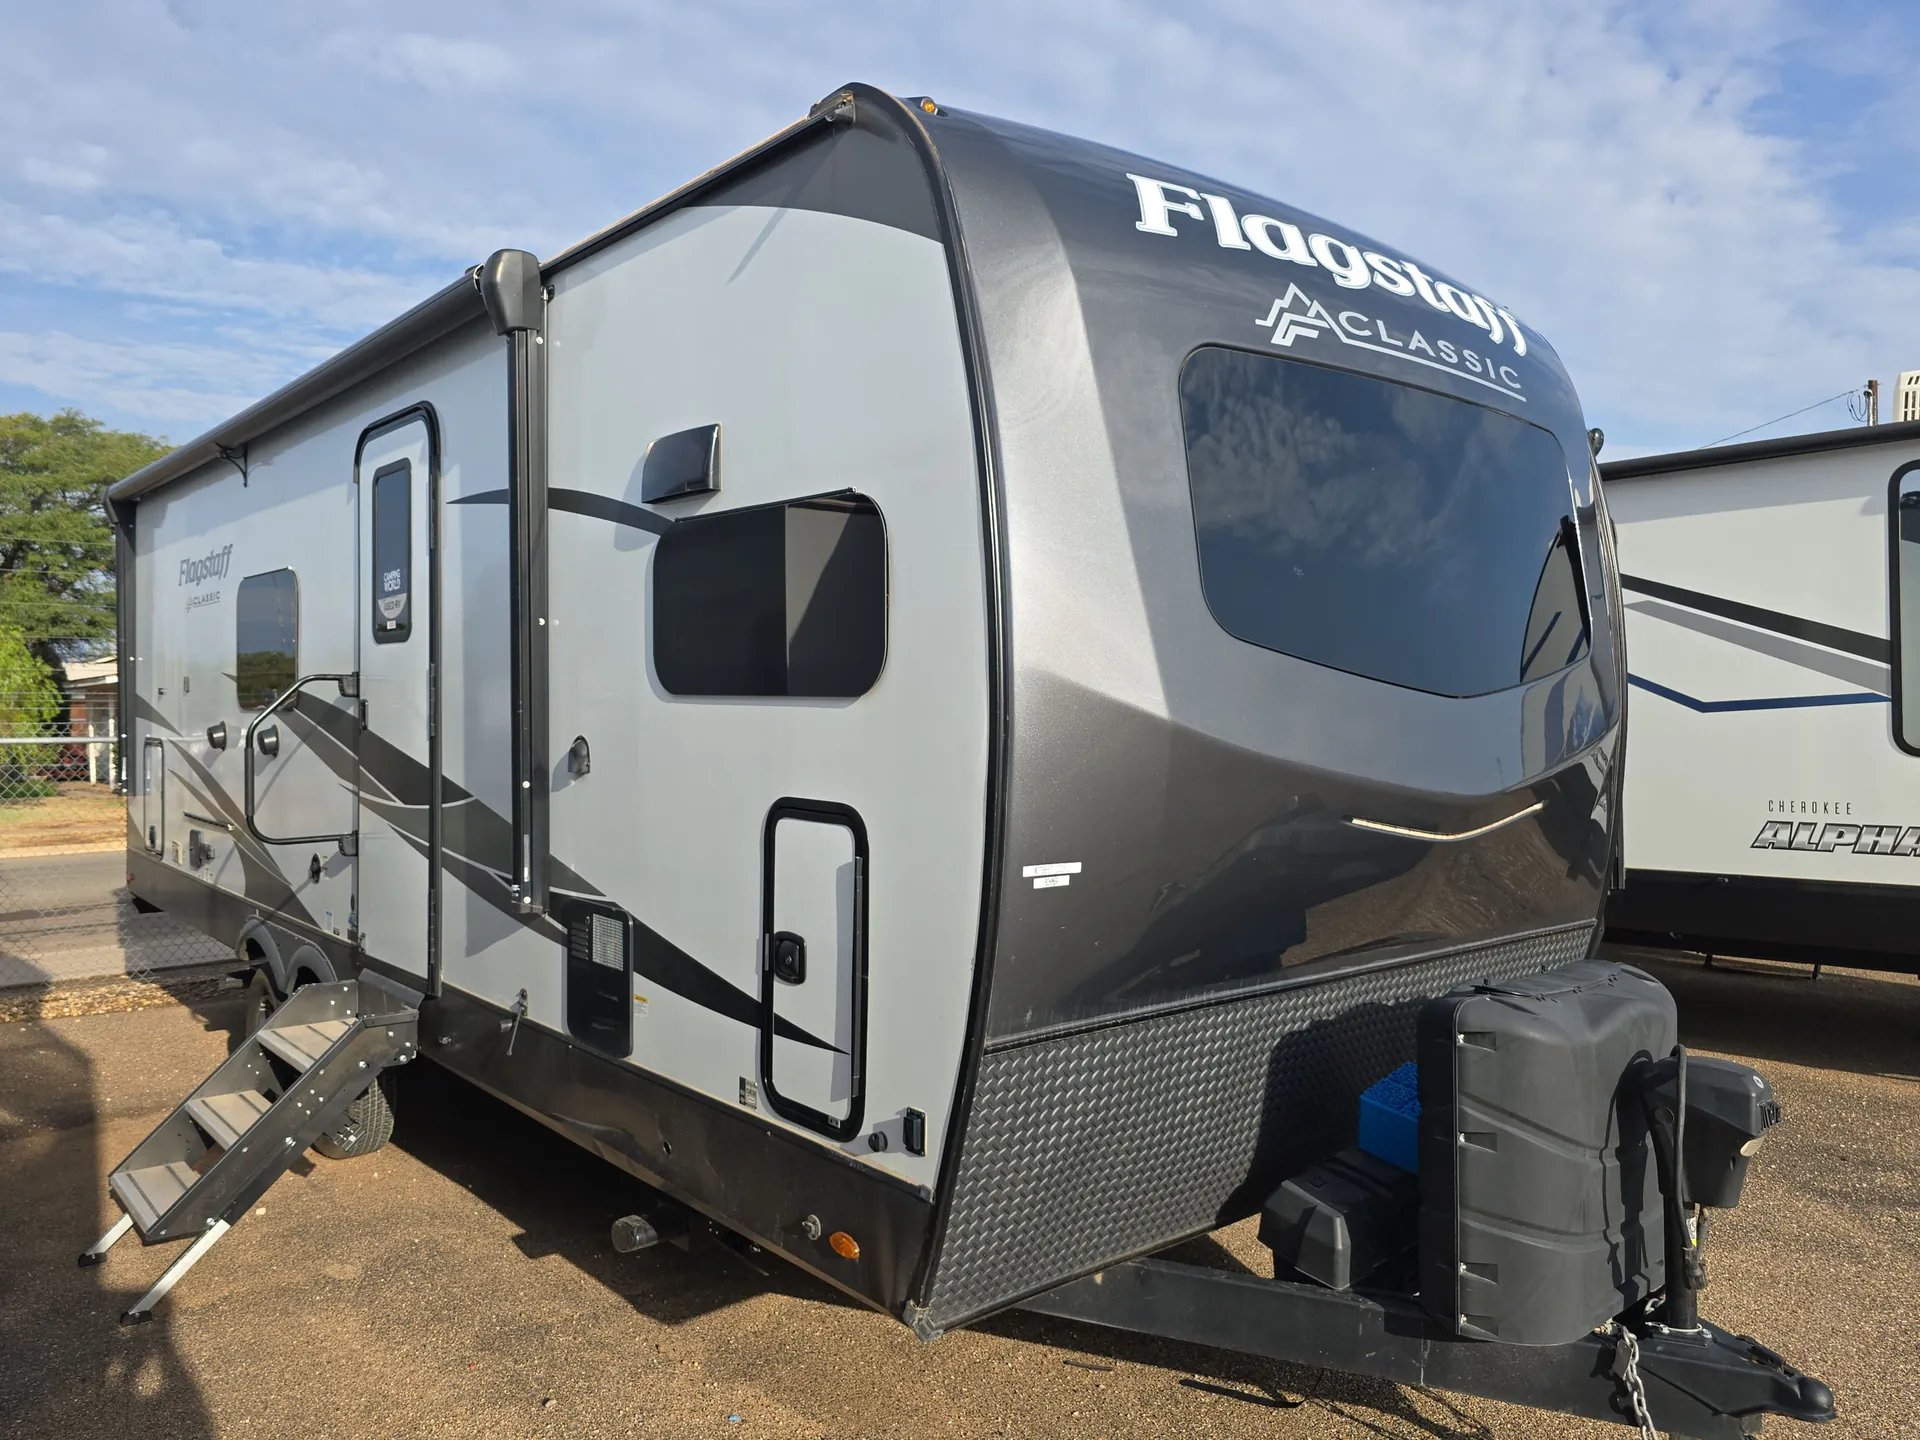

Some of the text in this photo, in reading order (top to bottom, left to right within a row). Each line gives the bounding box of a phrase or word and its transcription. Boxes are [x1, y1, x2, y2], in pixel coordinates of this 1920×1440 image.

[1126, 173, 1527, 357] Flagstaff
[1338, 311, 1522, 389] CLASSIC
[178, 543, 233, 587] Flagstaff
[192, 591, 221, 606] CLASSIC
[1768, 799, 1852, 816] CHEROKEE
